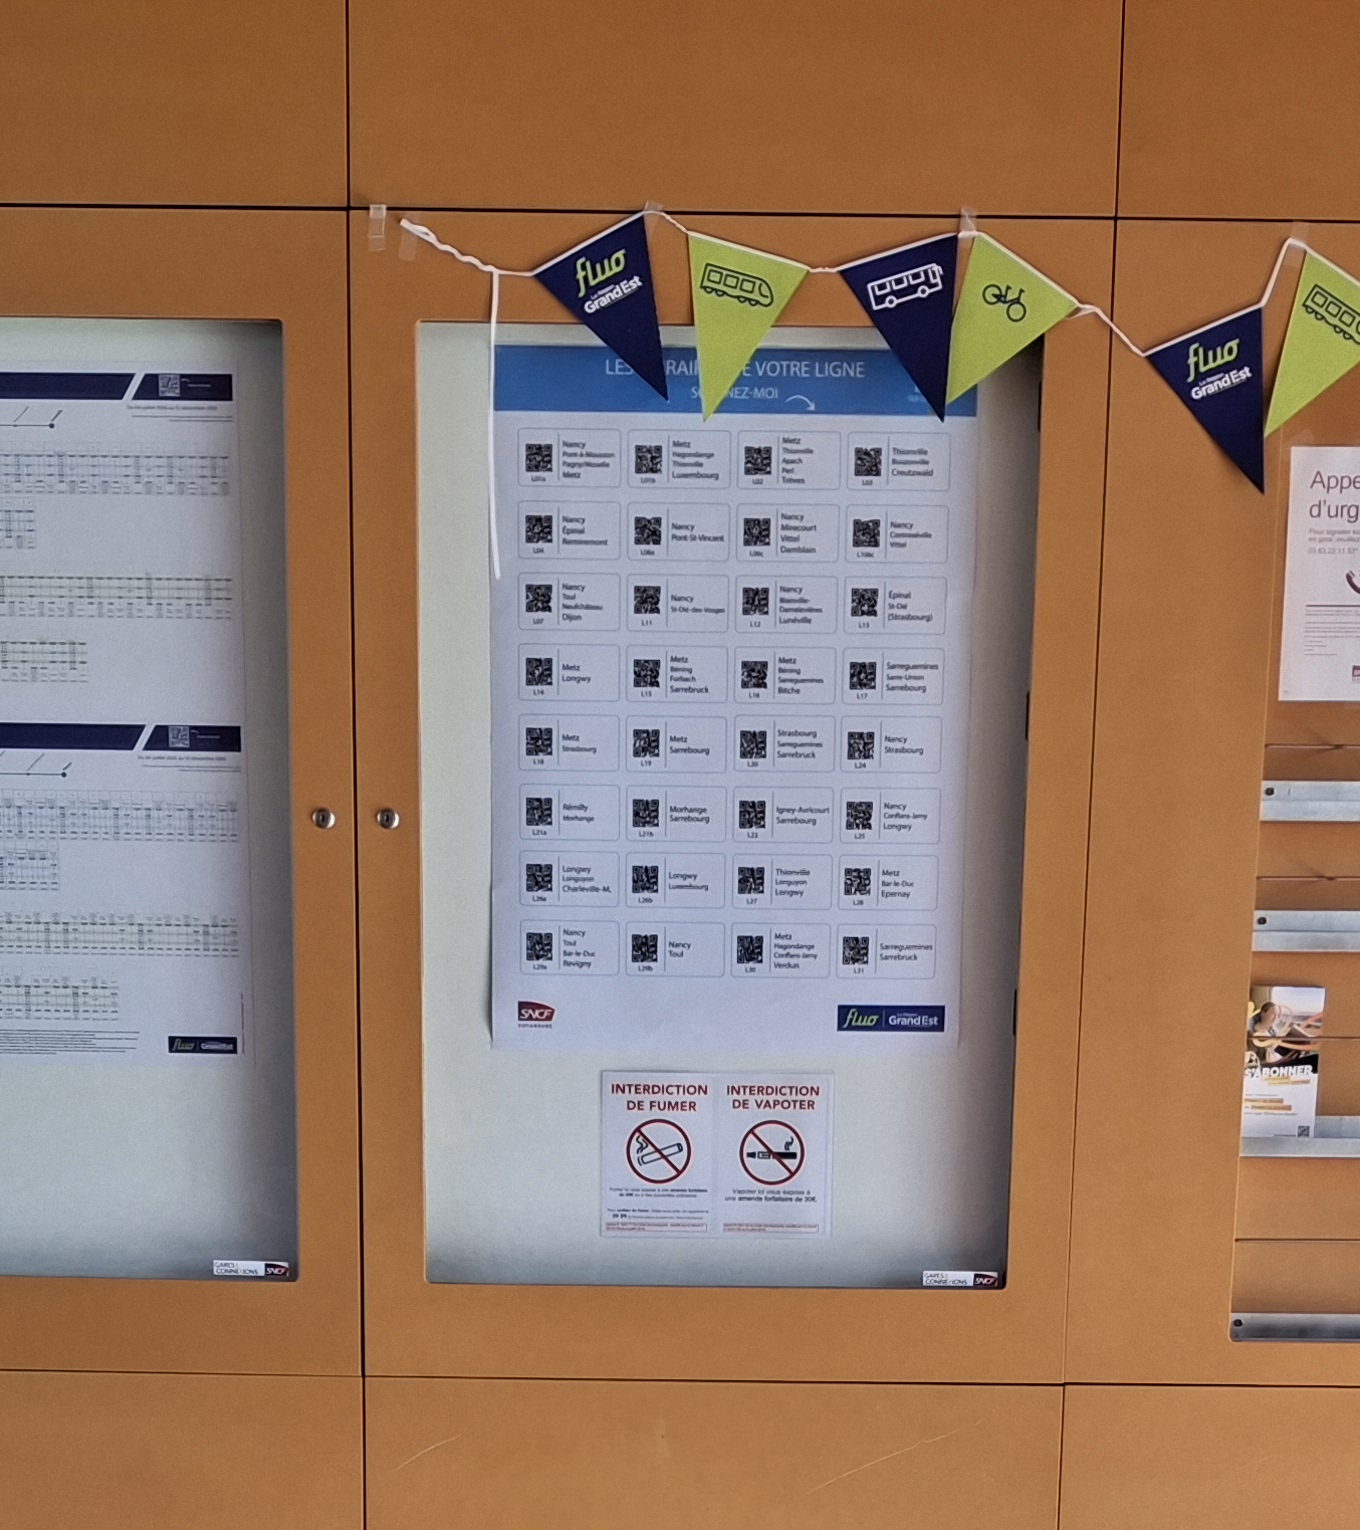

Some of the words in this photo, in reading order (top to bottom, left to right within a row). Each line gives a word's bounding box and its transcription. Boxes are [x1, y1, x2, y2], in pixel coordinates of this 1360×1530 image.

[576, 248, 625, 298] fluo
[1187, 338, 1240, 382] fluo
[755, 361, 810, 377] VOTRE
[815, 362, 864, 378] LIGNE
[562, 440, 585, 448] Nancy
[672, 471, 719, 480] Luxembourg
[562, 516, 585, 524] Nancy
[781, 513, 804, 522] Nancy
[671, 523, 695, 532] Nancy
[781, 524, 817, 532] Mirecourt
[890, 521, 913, 530] Nancy
[780, 546, 816, 554] Damblain
[562, 583, 585, 592] Nancy
[780, 586, 803, 594] Nancy
[671, 594, 693, 603] Nancy
[562, 613, 582, 622] Dijon
[670, 655, 689, 663] Metz
[562, 663, 580, 672] Metz
[670, 686, 709, 694] Sarrebruck
[562, 734, 580, 742] Metz
[777, 729, 817, 738] Strasbourg
[670, 735, 687, 743] Metz
[885, 736, 907, 744] Nancy
[670, 746, 709, 755] Sarrebourg
[777, 751, 816, 759] Sarrebruck
[884, 746, 924, 755] Strasbourg
[670, 806, 707, 814] Morhange
[884, 802, 907, 811] Nancy
[670, 815, 710, 824] Sarrebourg
[777, 817, 817, 825] Sarrebourg
[669, 872, 697, 881] Longwy
[882, 869, 900, 877] Metz
[563, 929, 586, 937] Nancy
[774, 933, 792, 941] Metz
[669, 941, 691, 950] Nancy
[880, 953, 917, 961] Sarrebruck
[520, 1008, 551, 1019] SNCF
[842, 1008, 879, 1028] fluo
[611, 1084, 708, 1095] INTERDICTION
[727, 1085, 820, 1096] INTERDICTION
[627, 1101, 645, 1111] DE
[650, 1101, 696, 1111] FUMER
[732, 1100, 749, 1109] DE
[755, 1100, 815, 1110] VAPOTER
